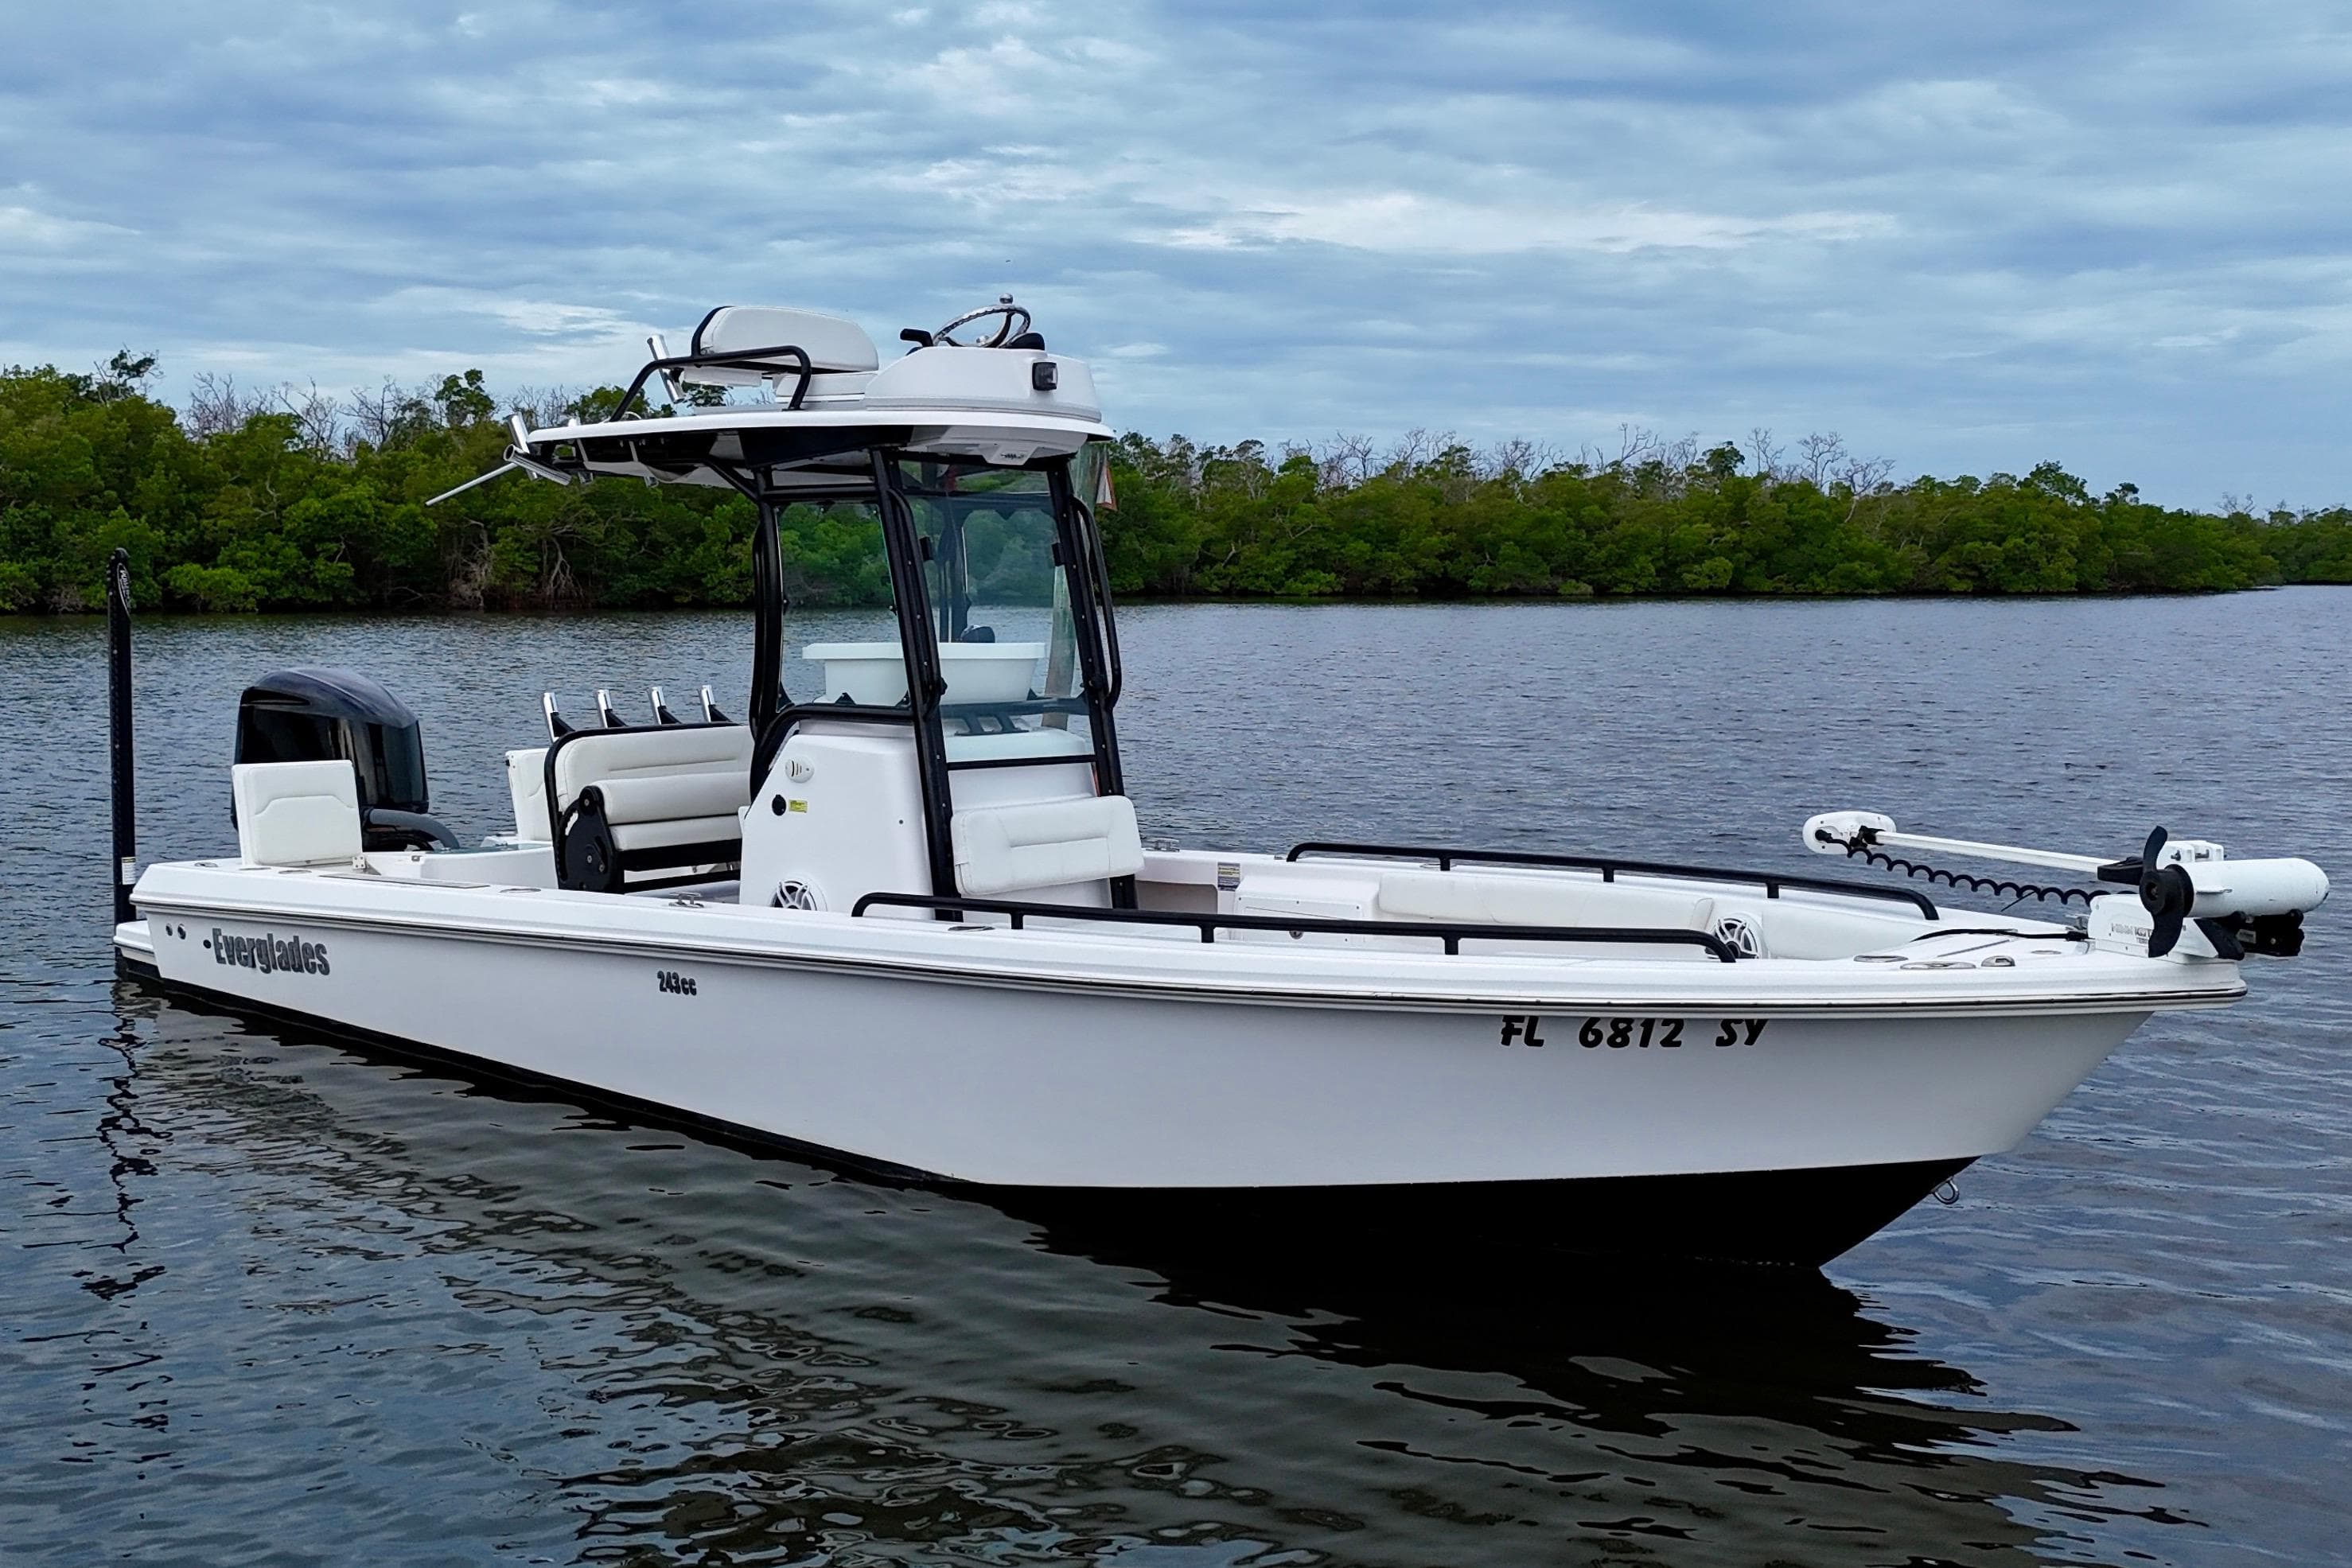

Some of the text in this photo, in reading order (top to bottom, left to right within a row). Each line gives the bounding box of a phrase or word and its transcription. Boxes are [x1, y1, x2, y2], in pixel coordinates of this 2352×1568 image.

[212, 928, 330, 975] Everglades
[657, 971, 697, 996] 243cc
[1501, 1014, 1770, 1049] FL 6812 SY
